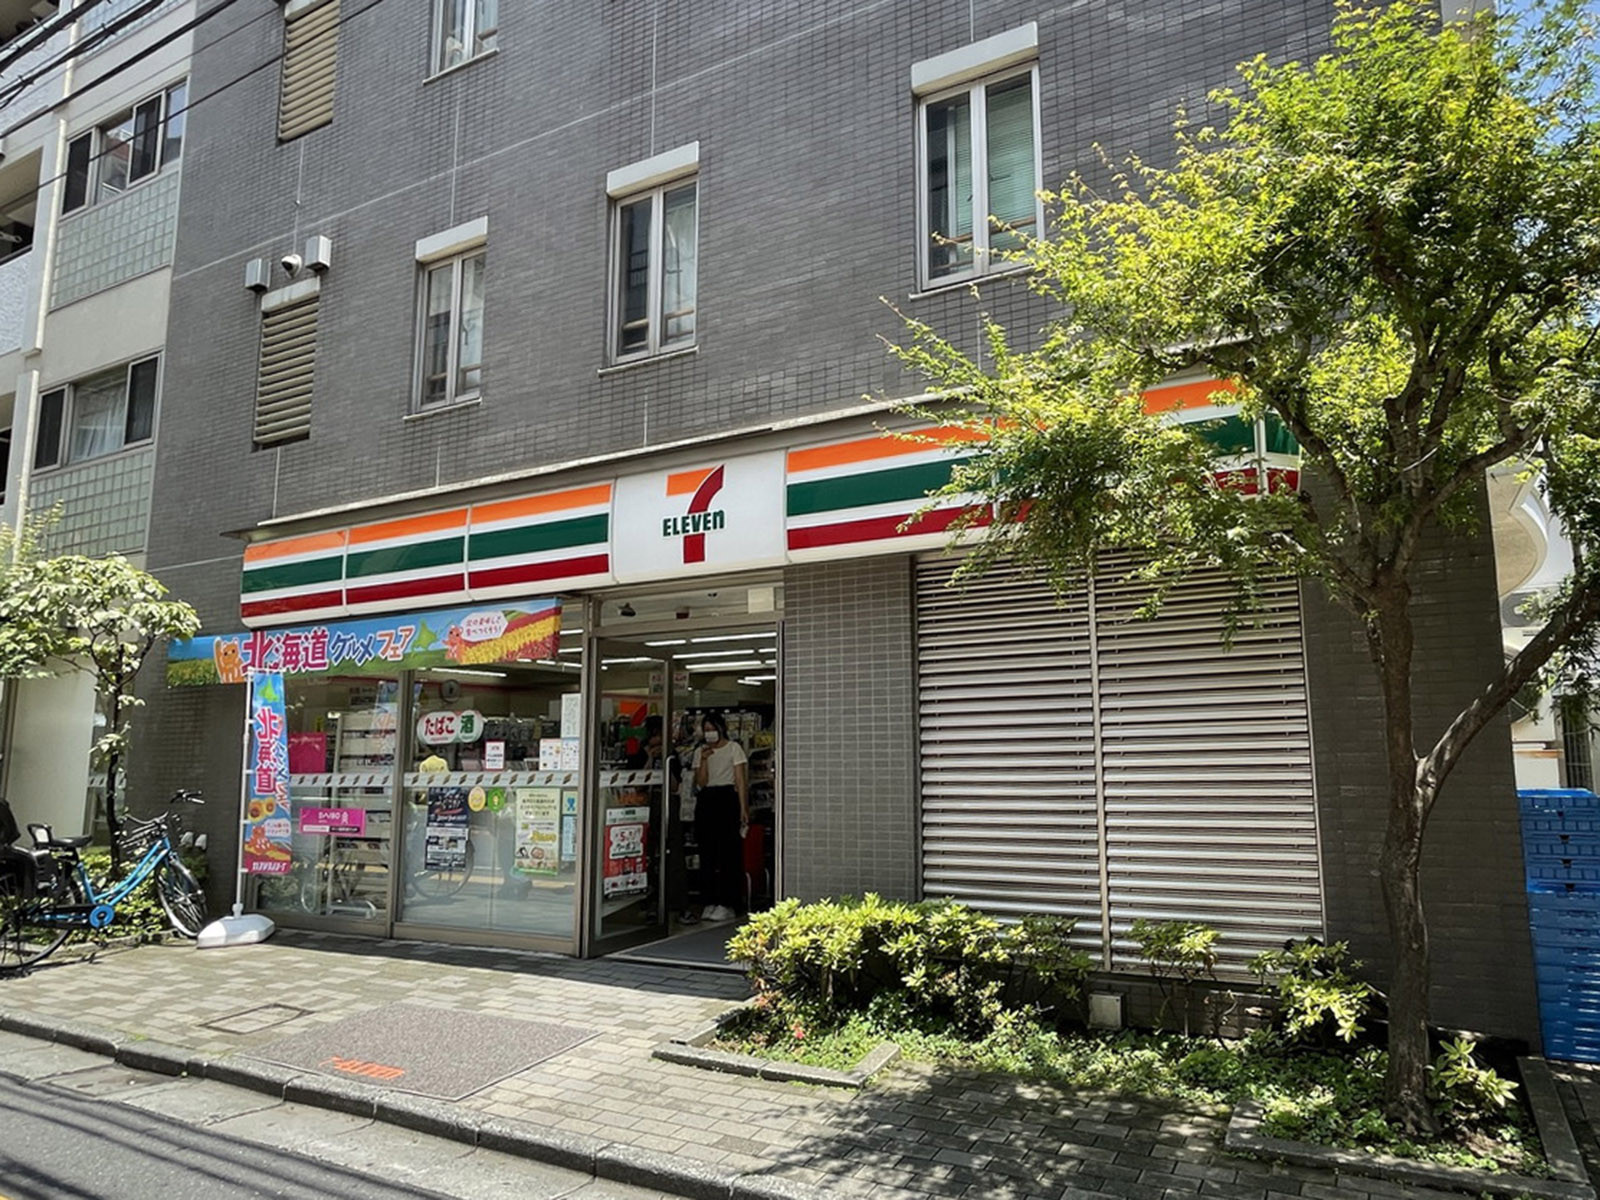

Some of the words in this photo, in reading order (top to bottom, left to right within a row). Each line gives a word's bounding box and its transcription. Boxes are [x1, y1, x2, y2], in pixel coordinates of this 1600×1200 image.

[666, 464, 725, 564] 7
[425, 715, 455, 736] たばこ
[460, 714, 475, 735] 酒
